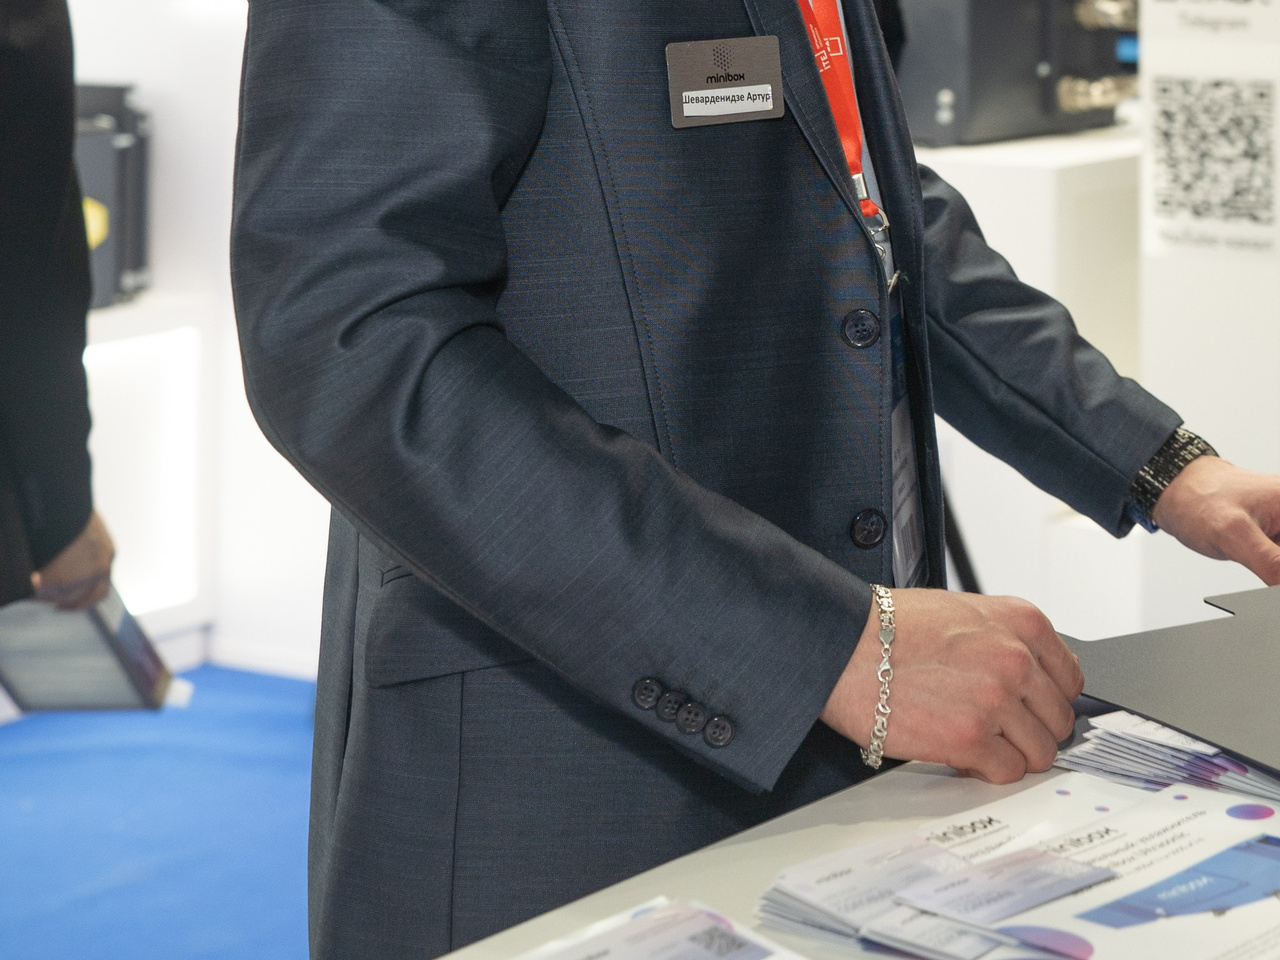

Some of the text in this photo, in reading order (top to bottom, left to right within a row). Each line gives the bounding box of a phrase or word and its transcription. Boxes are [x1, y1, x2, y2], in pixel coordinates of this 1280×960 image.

[706, 72, 745, 84] minibox
[683, 92, 771, 105] Шеварденидзе Артур
